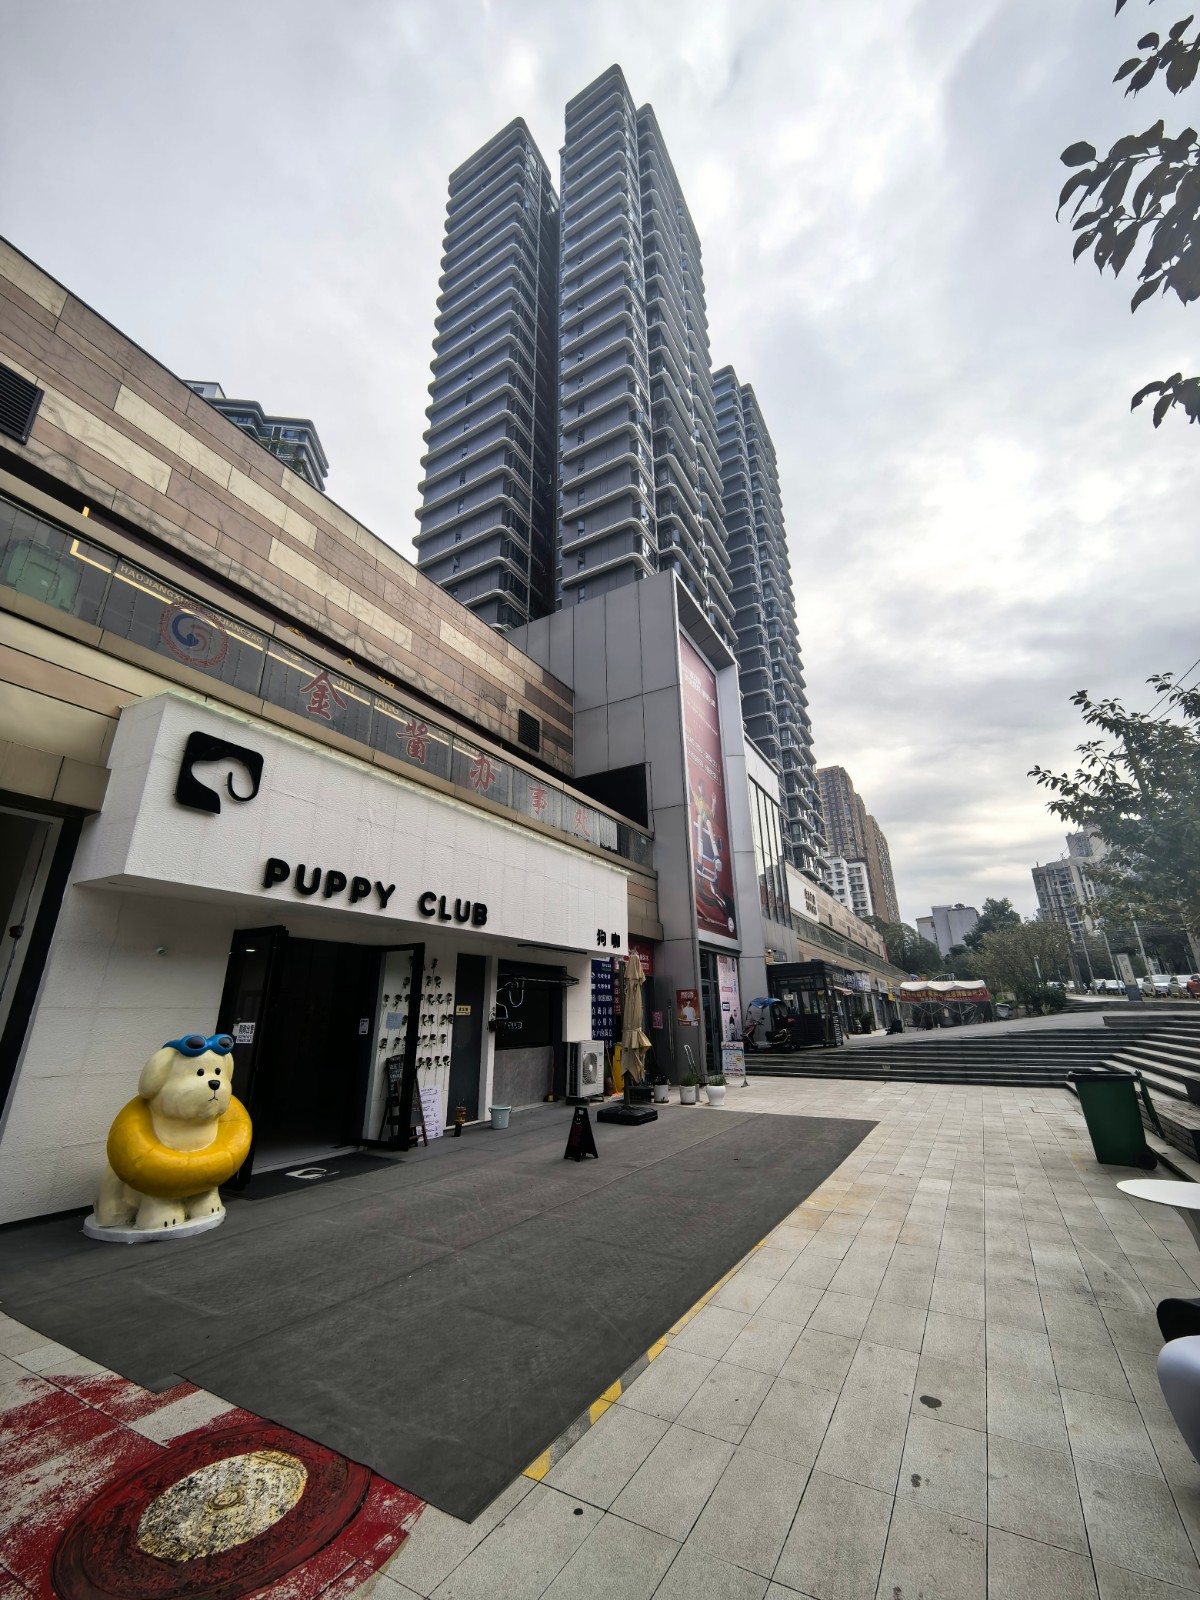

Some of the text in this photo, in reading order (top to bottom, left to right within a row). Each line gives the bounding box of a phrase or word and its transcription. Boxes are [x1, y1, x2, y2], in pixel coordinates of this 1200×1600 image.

[262, 857, 488, 927] PUPPY CLUB
[596, 928, 621, 949] 狗咖
